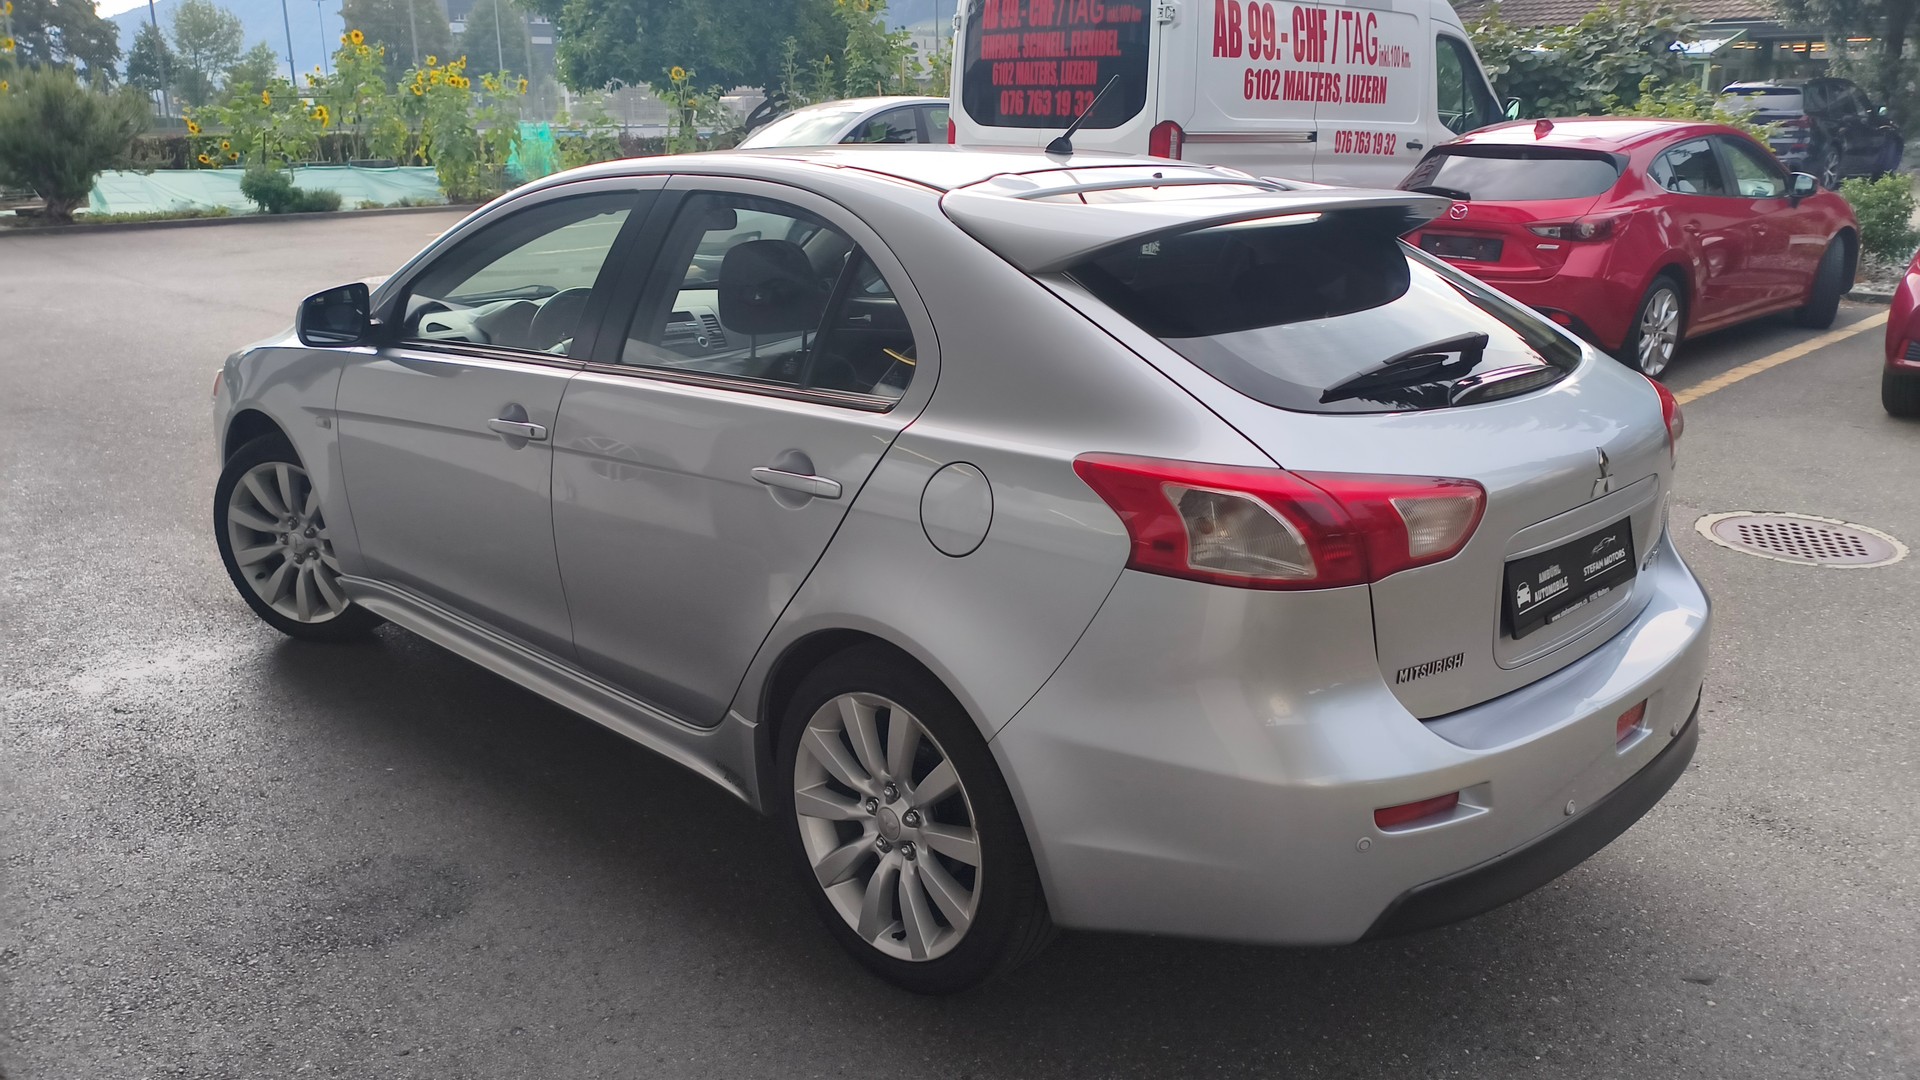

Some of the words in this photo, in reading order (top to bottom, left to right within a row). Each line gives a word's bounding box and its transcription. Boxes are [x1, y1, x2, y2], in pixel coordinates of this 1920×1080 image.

[1212, 0, 1242, 58] AB
[1247, 2, 1288, 61] 99.-
[1292, 5, 1327, 63] CHF
[992, 62, 1014, 86] 6102
[1015, 61, 1058, 87] MALTERS,
[1060, 60, 1098, 85] LUZERN
[1244, 68, 1280, 101] 6102
[1283, 70, 1342, 105] MALTERS,
[1345, 74, 1388, 104] LUZERN
[1000, 90, 1024, 116] 076
[1027, 90, 1052, 116] 763
[1055, 90, 1071, 116] 19
[1334, 131, 1352, 154] 076
[1353, 132, 1370, 154] 763
[1372, 133, 1382, 155] 19
[1383, 133, 1397, 155] 32
[1583, 559, 1604, 576] STEFAN
[1604, 548, 1626, 566] MOTORS
[1534, 576, 1569, 602] AUTOMOBILE
[1396, 652, 1466, 684] MITSUBISHI
